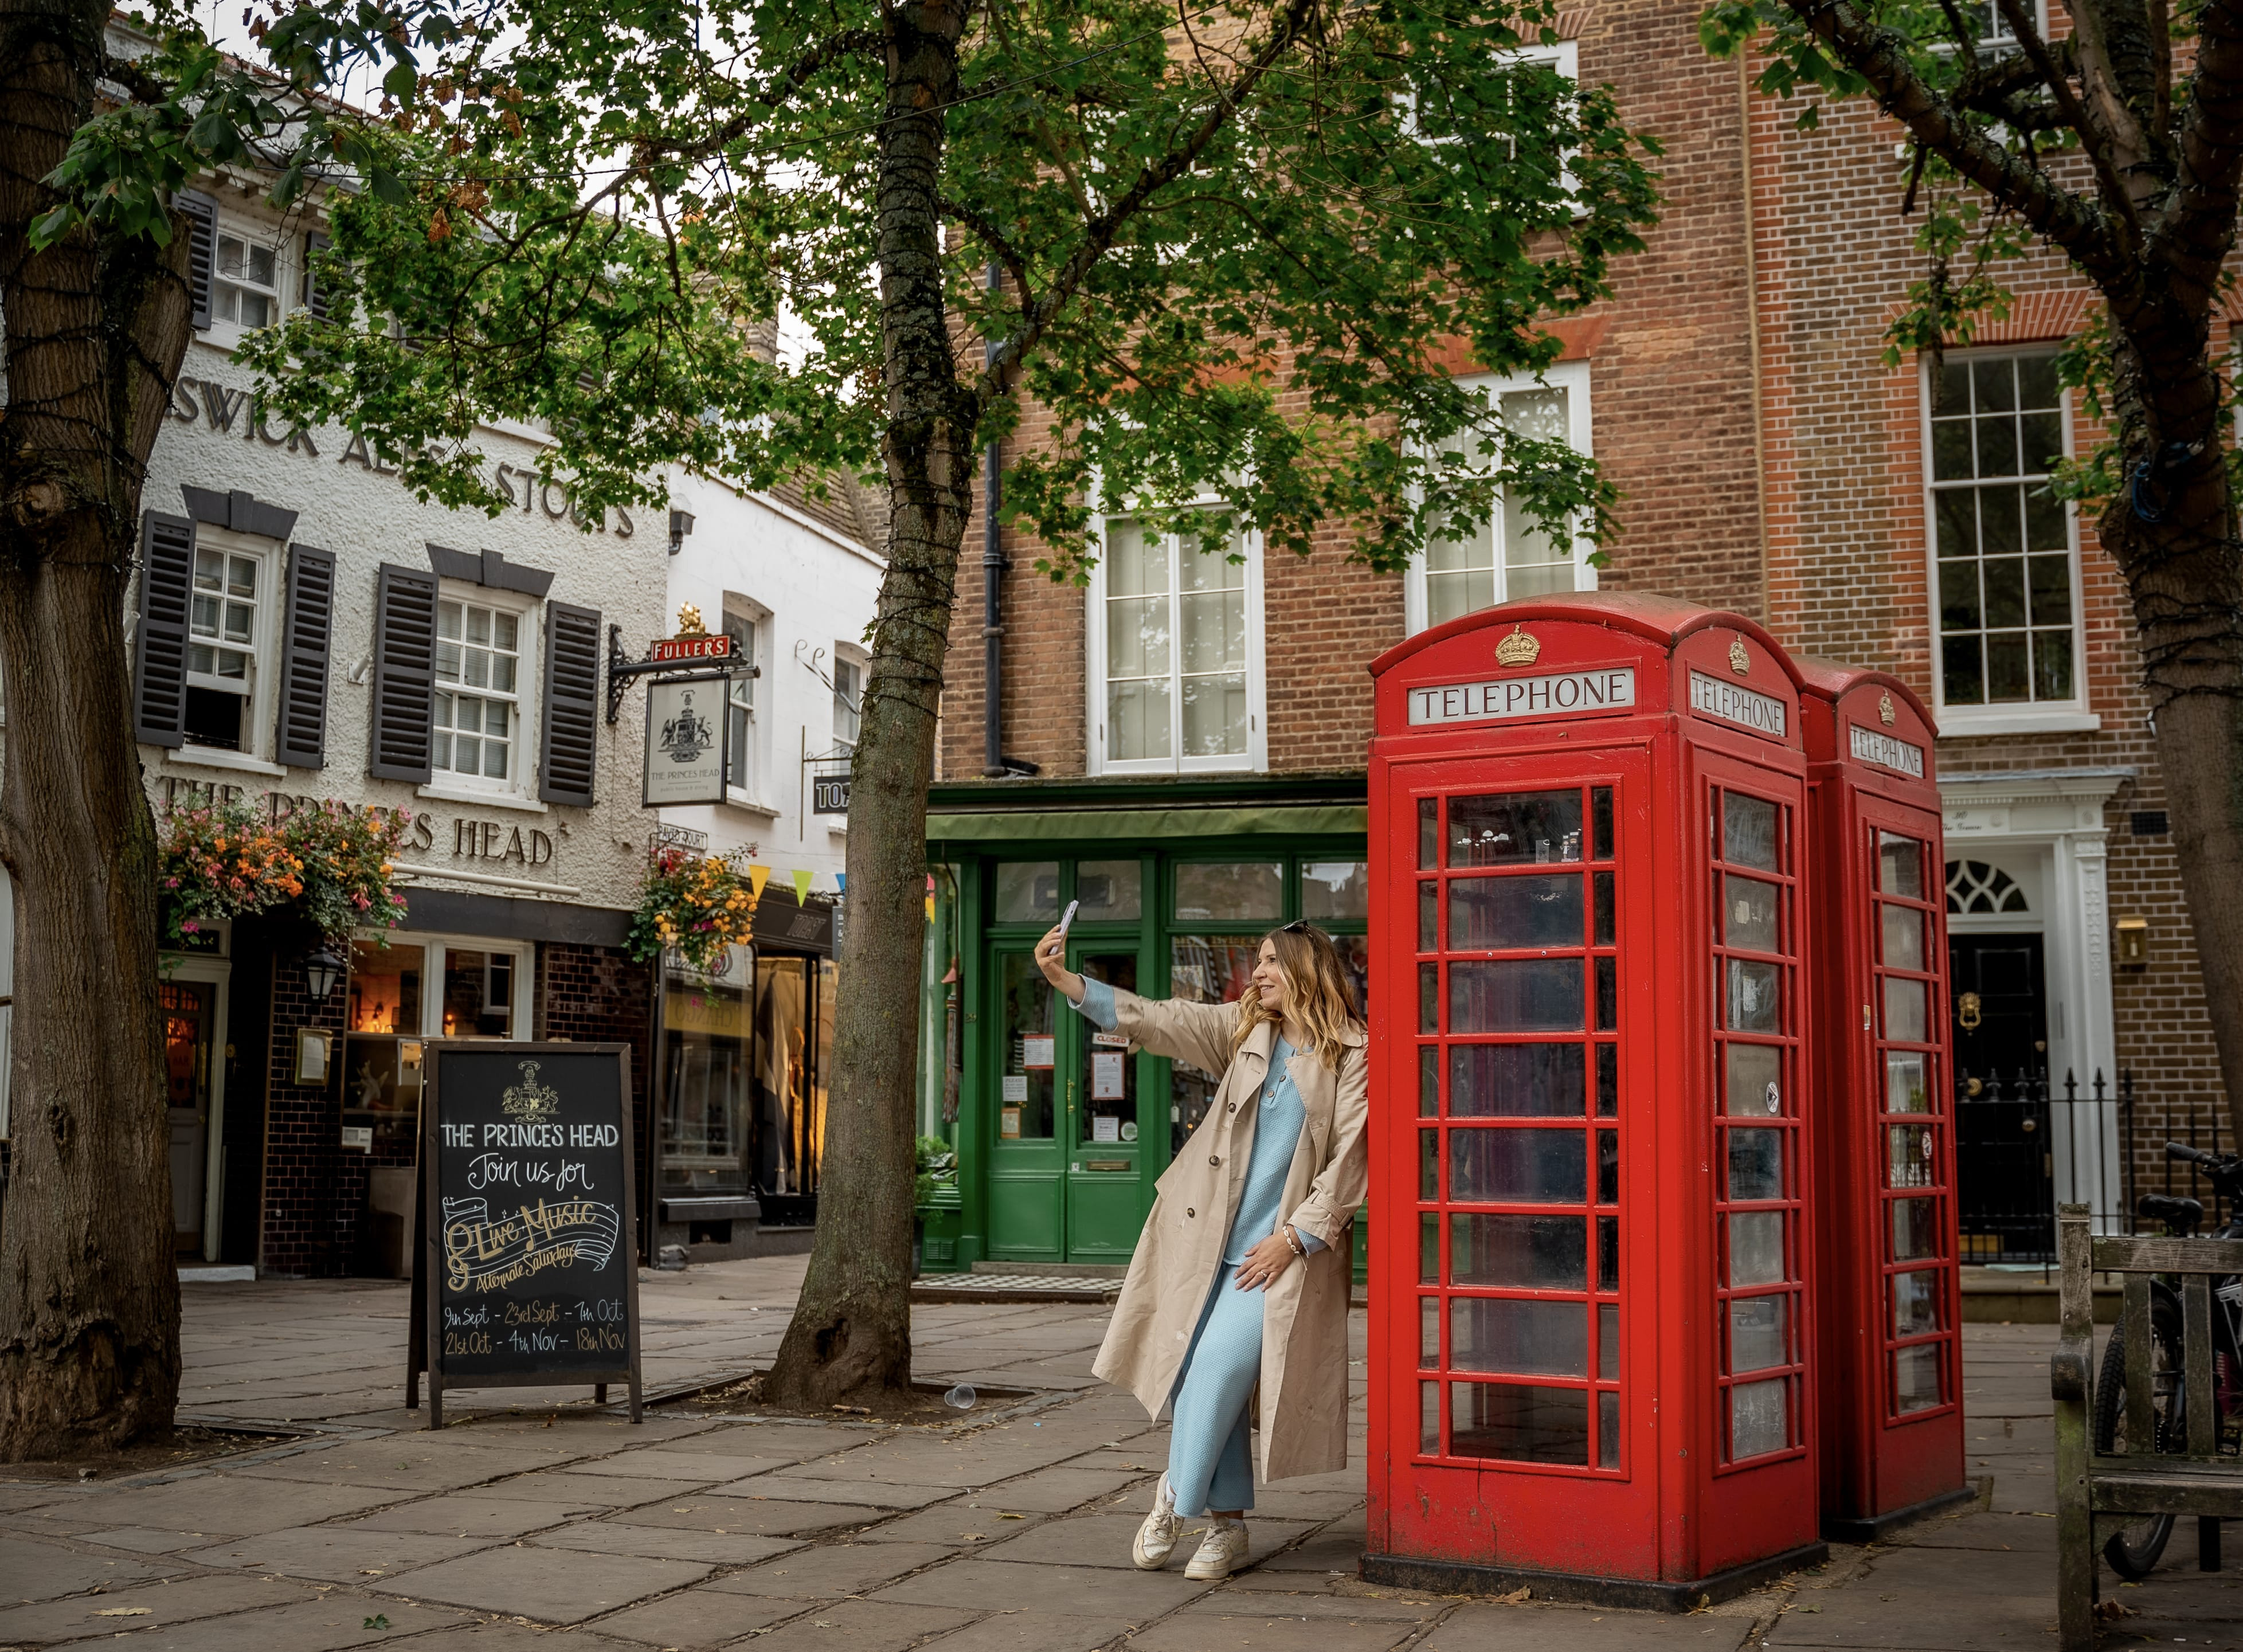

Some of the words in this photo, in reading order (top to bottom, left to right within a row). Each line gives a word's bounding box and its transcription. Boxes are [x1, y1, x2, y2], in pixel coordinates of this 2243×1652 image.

[166, 375, 320, 457] SWIK
[654, 638, 724, 660] FULLER'S
[1417, 672, 1627, 719] TELEPHONE
[1692, 676, 1782, 733] TELEPHONE
[1850, 729, 1921, 774] TELEPHONE
[651, 772, 665, 781] THE
[668, 770, 697, 780] PRINCES
[699, 768, 720, 778] HEAD
[453, 819, 553, 864] HEAD
[1097, 1036, 1126, 1044] CLOSED
[440, 1124, 475, 1147] THE
[484, 1123, 563, 1148] PRINCE'S
[570, 1124, 619, 1148] HEAD
[468, 1153, 522, 1189] Join
[527, 1162, 555, 1183] us
[556, 1159, 594, 1192] for
[475, 1222, 519, 1261] Live
[520, 1196, 597, 1252] Music
[476, 1260, 525, 1294] Alternate
[522, 1243, 577, 1277] Saturdays
[445, 1307, 461, 1330] 9th
[462, 1304, 490, 1329] Sept
[505, 1302, 531, 1326] 23rd
[532, 1300, 560, 1327] Sept
[574, 1301, 594, 1322] 7th
[597, 1298, 624, 1322] Oct
[445, 1332, 468, 1355] 21st
[469, 1331, 492, 1355] Oct
[508, 1329, 530, 1354] 4th
[532, 1328, 559, 1351] Nov
[577, 1327, 601, 1353] 18th
[598, 1323, 626, 1350] Nov
